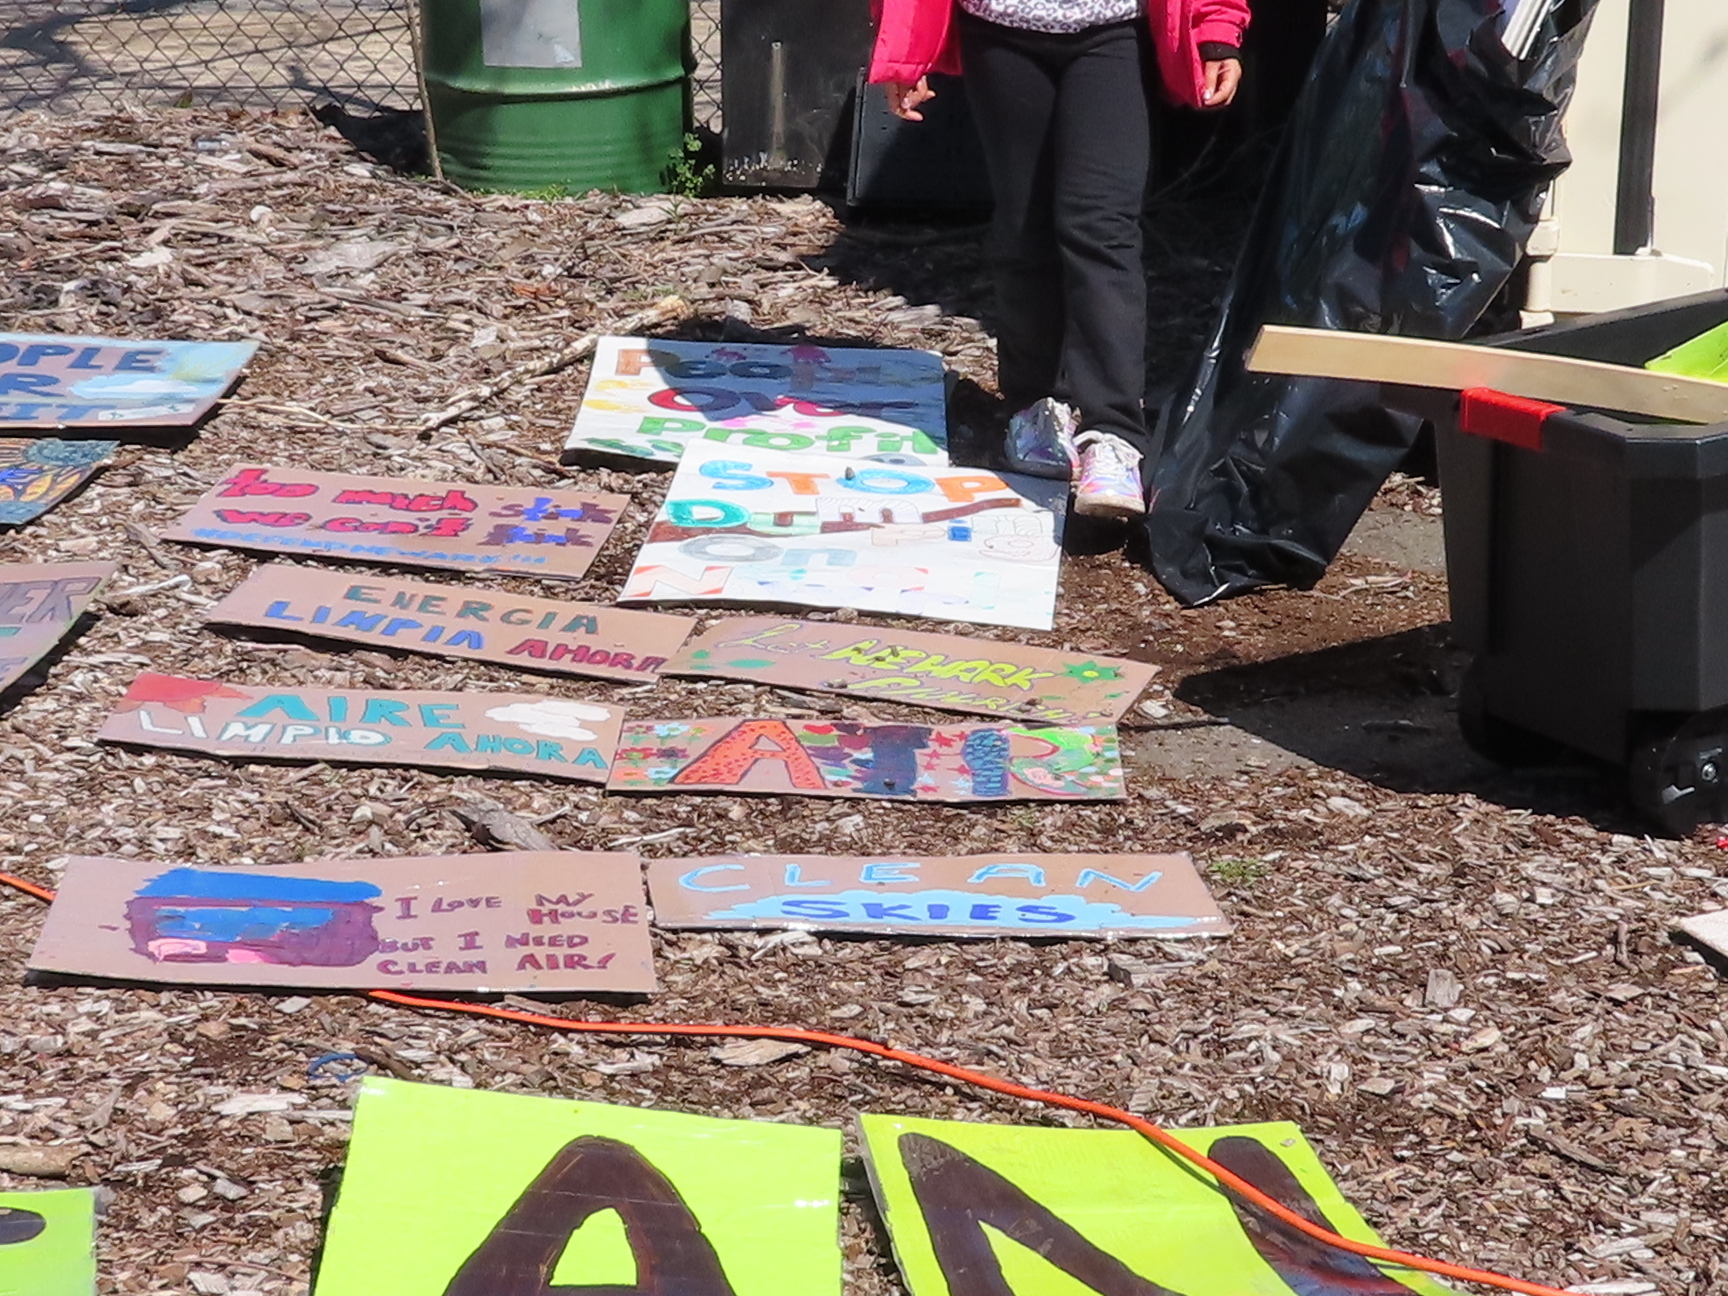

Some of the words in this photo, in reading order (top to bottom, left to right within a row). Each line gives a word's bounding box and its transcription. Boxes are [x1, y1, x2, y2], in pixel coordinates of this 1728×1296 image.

[699, 460, 1011, 503] STOP
[331, 489, 479, 512] much
[265, 600, 486, 651] LIMPIA
[343, 584, 599, 635] ENERGIA
[819, 638, 1057, 691] NEWARK
[235, 693, 467, 729] AIRE
[138, 710, 392, 746] LIMPIO
[422, 731, 610, 770] AHORA
[673, 719, 1102, 798] AIR
[678, 863, 1163, 892] CLEAN
[394, 895, 419, 920] I
[430, 896, 503, 913] LOVE
[535, 891, 595, 906] MY
[526, 904, 640, 925] HOUSE
[780, 898, 1077, 924] SKIES
[378, 935, 436, 954] BUT
[457, 930, 484, 952] I
[504, 932, 590, 949] NEED
[376, 959, 489, 976] CLEAN
[515, 952, 617, 972] AIR!
